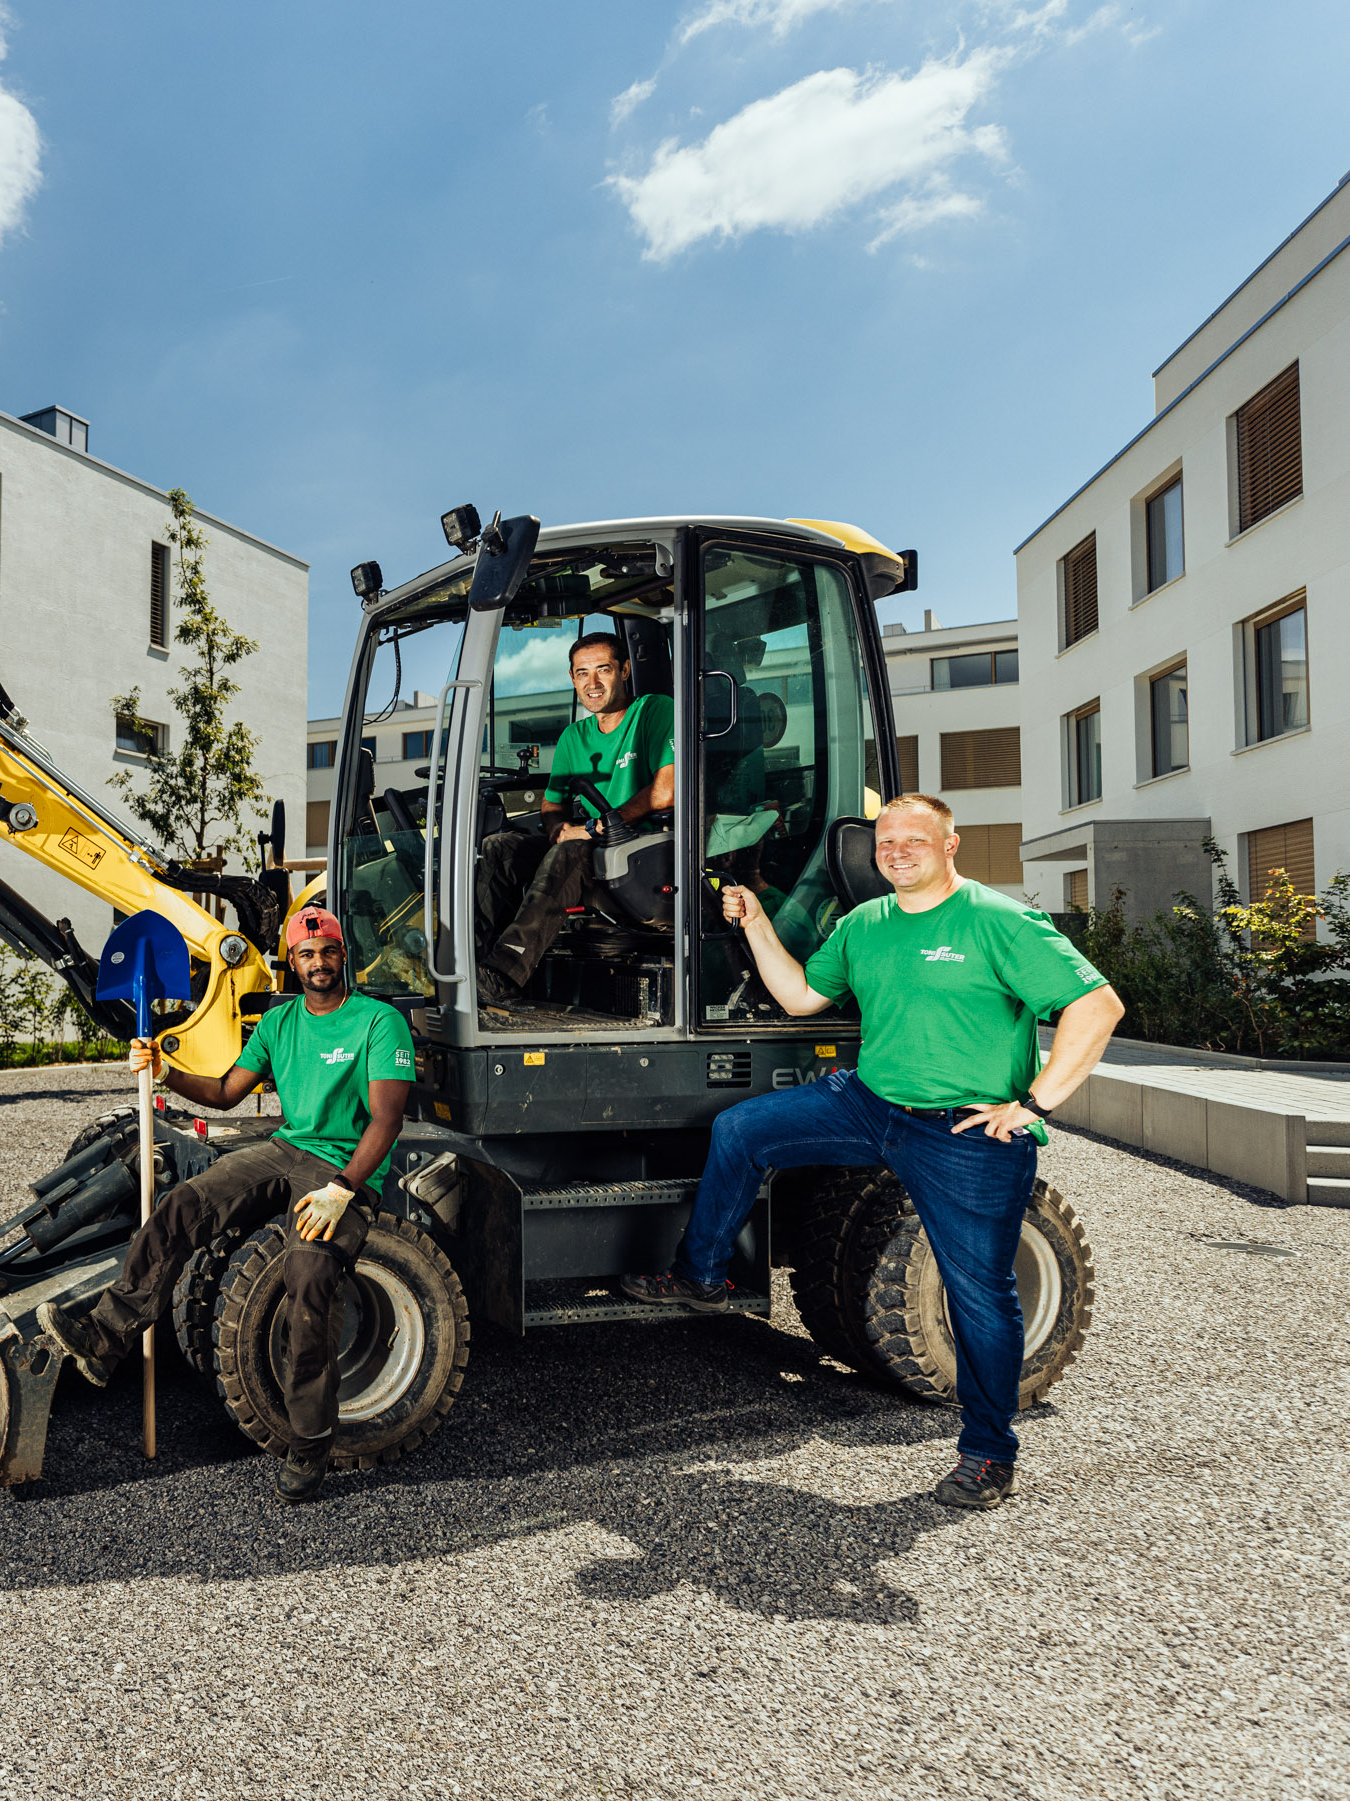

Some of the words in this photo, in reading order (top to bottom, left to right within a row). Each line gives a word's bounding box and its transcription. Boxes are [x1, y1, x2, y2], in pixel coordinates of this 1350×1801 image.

[940, 951, 965, 959] SUTER
[395, 1057, 411, 1065] 1982
[772, 1066, 838, 1090] EW
